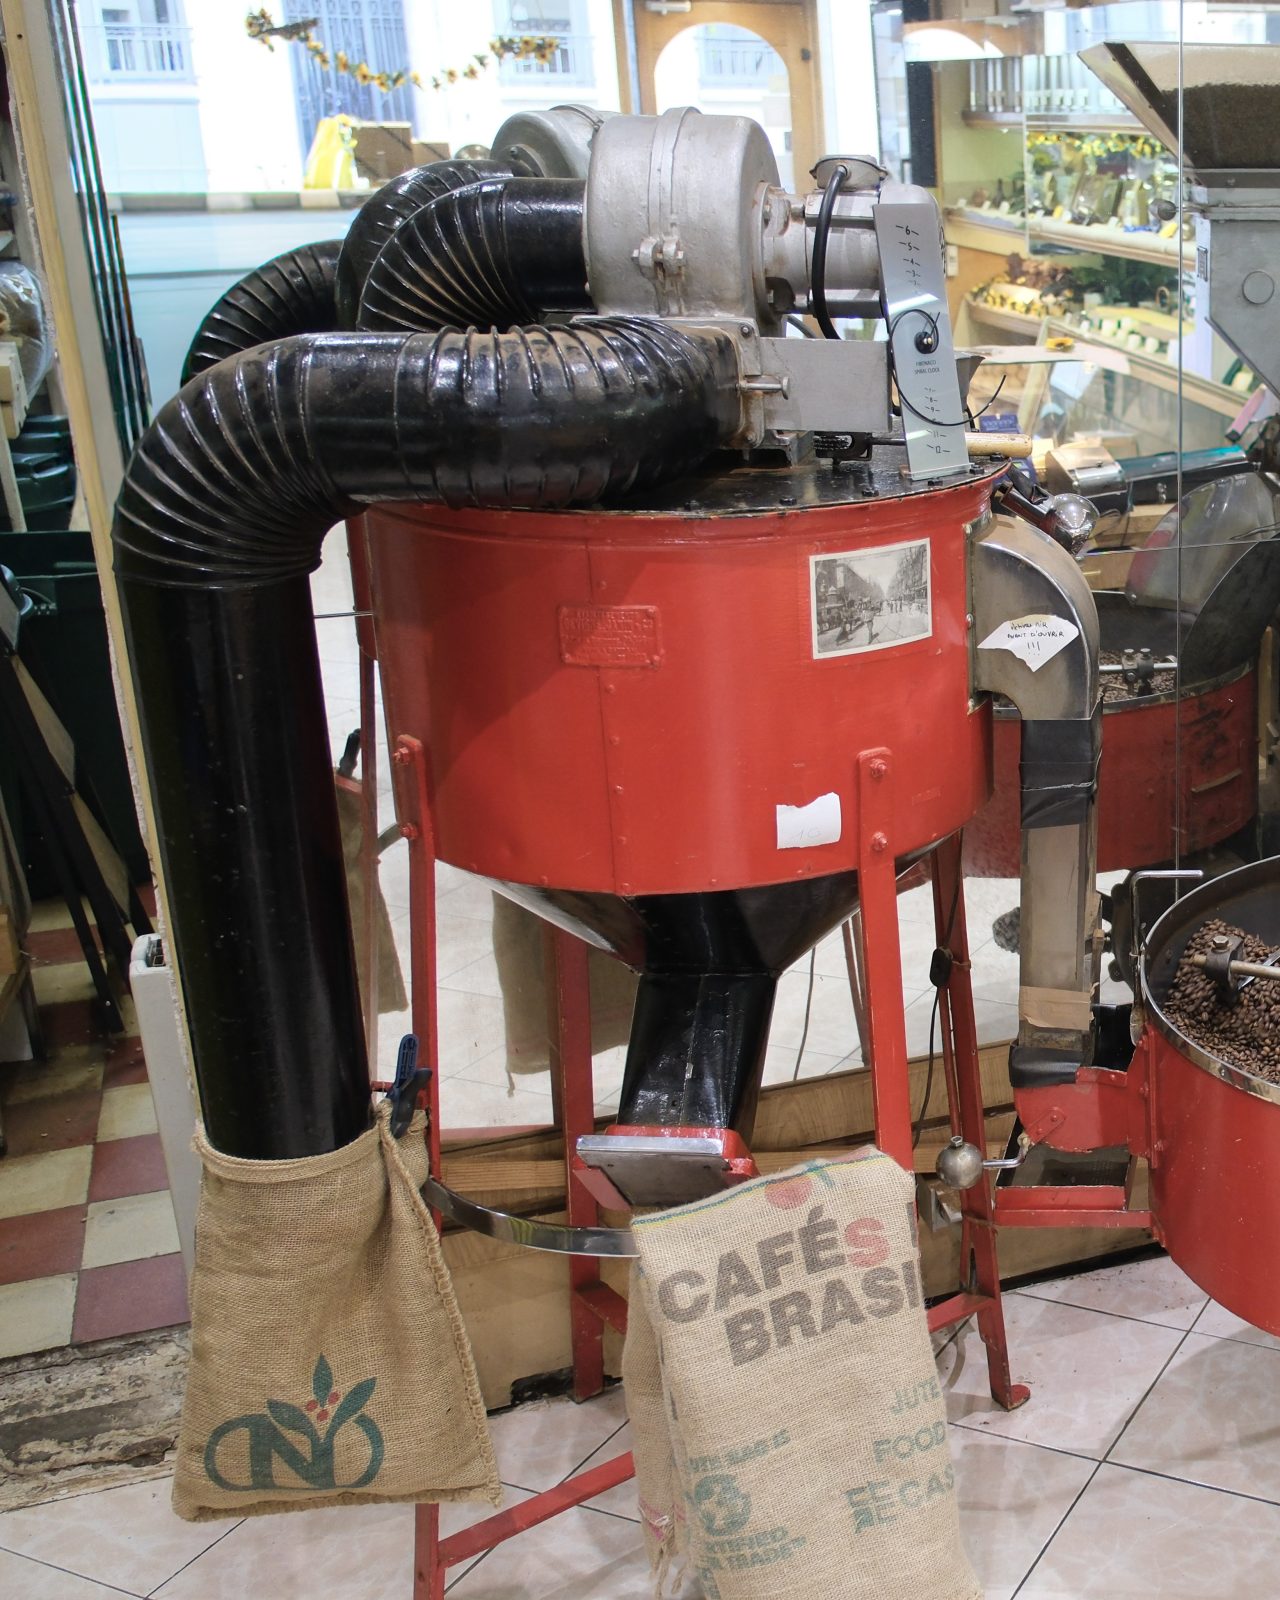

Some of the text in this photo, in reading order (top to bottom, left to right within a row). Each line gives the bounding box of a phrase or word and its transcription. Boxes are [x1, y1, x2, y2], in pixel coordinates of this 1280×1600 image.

[905, 225, 911, 235] 6
[907, 242, 913, 251] 5
[935, 445, 942, 454] 12
[658, 1204, 890, 1323] CAFÉS
[873, 1420, 947, 1465] FOOD
